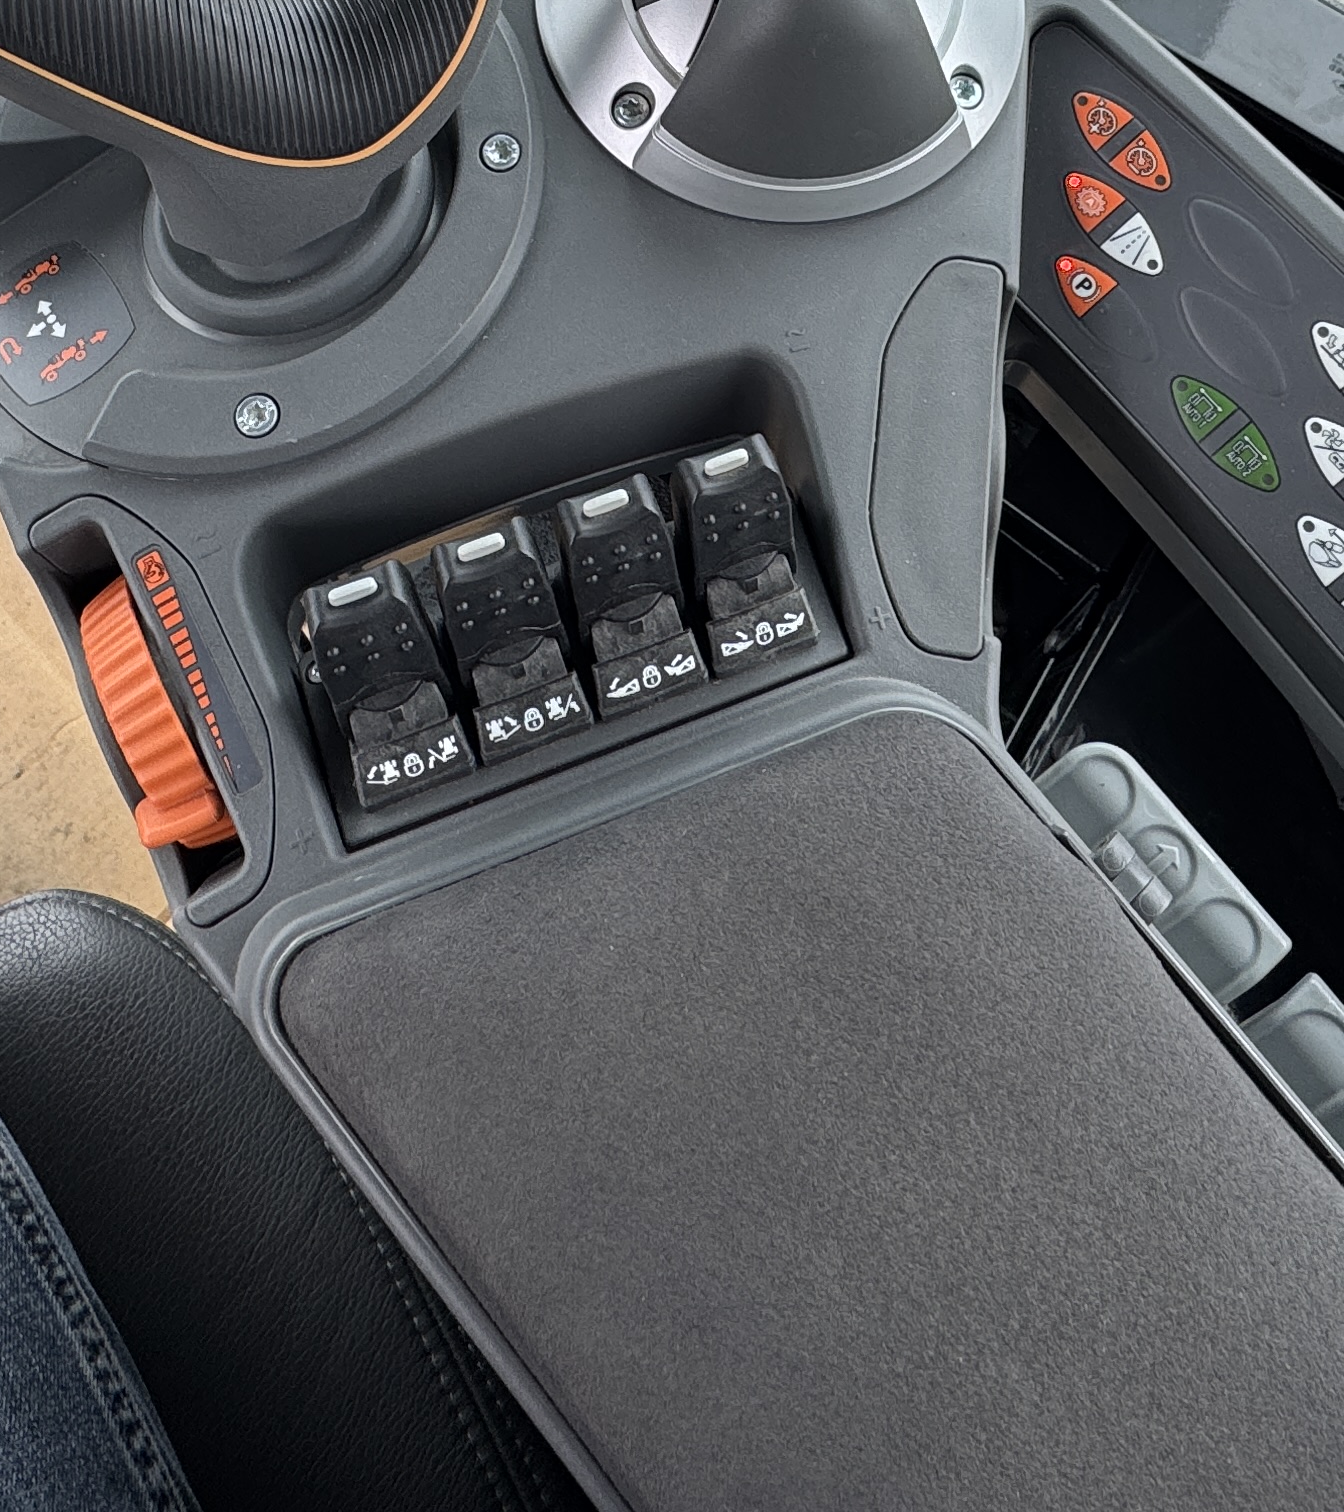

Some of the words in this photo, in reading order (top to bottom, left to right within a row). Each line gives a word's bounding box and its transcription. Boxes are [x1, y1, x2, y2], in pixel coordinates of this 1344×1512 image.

[1182, 402, 1202, 422] AUTO
[1226, 451, 1246, 470] AUTO
[1242, 468, 1252, 477] 2
